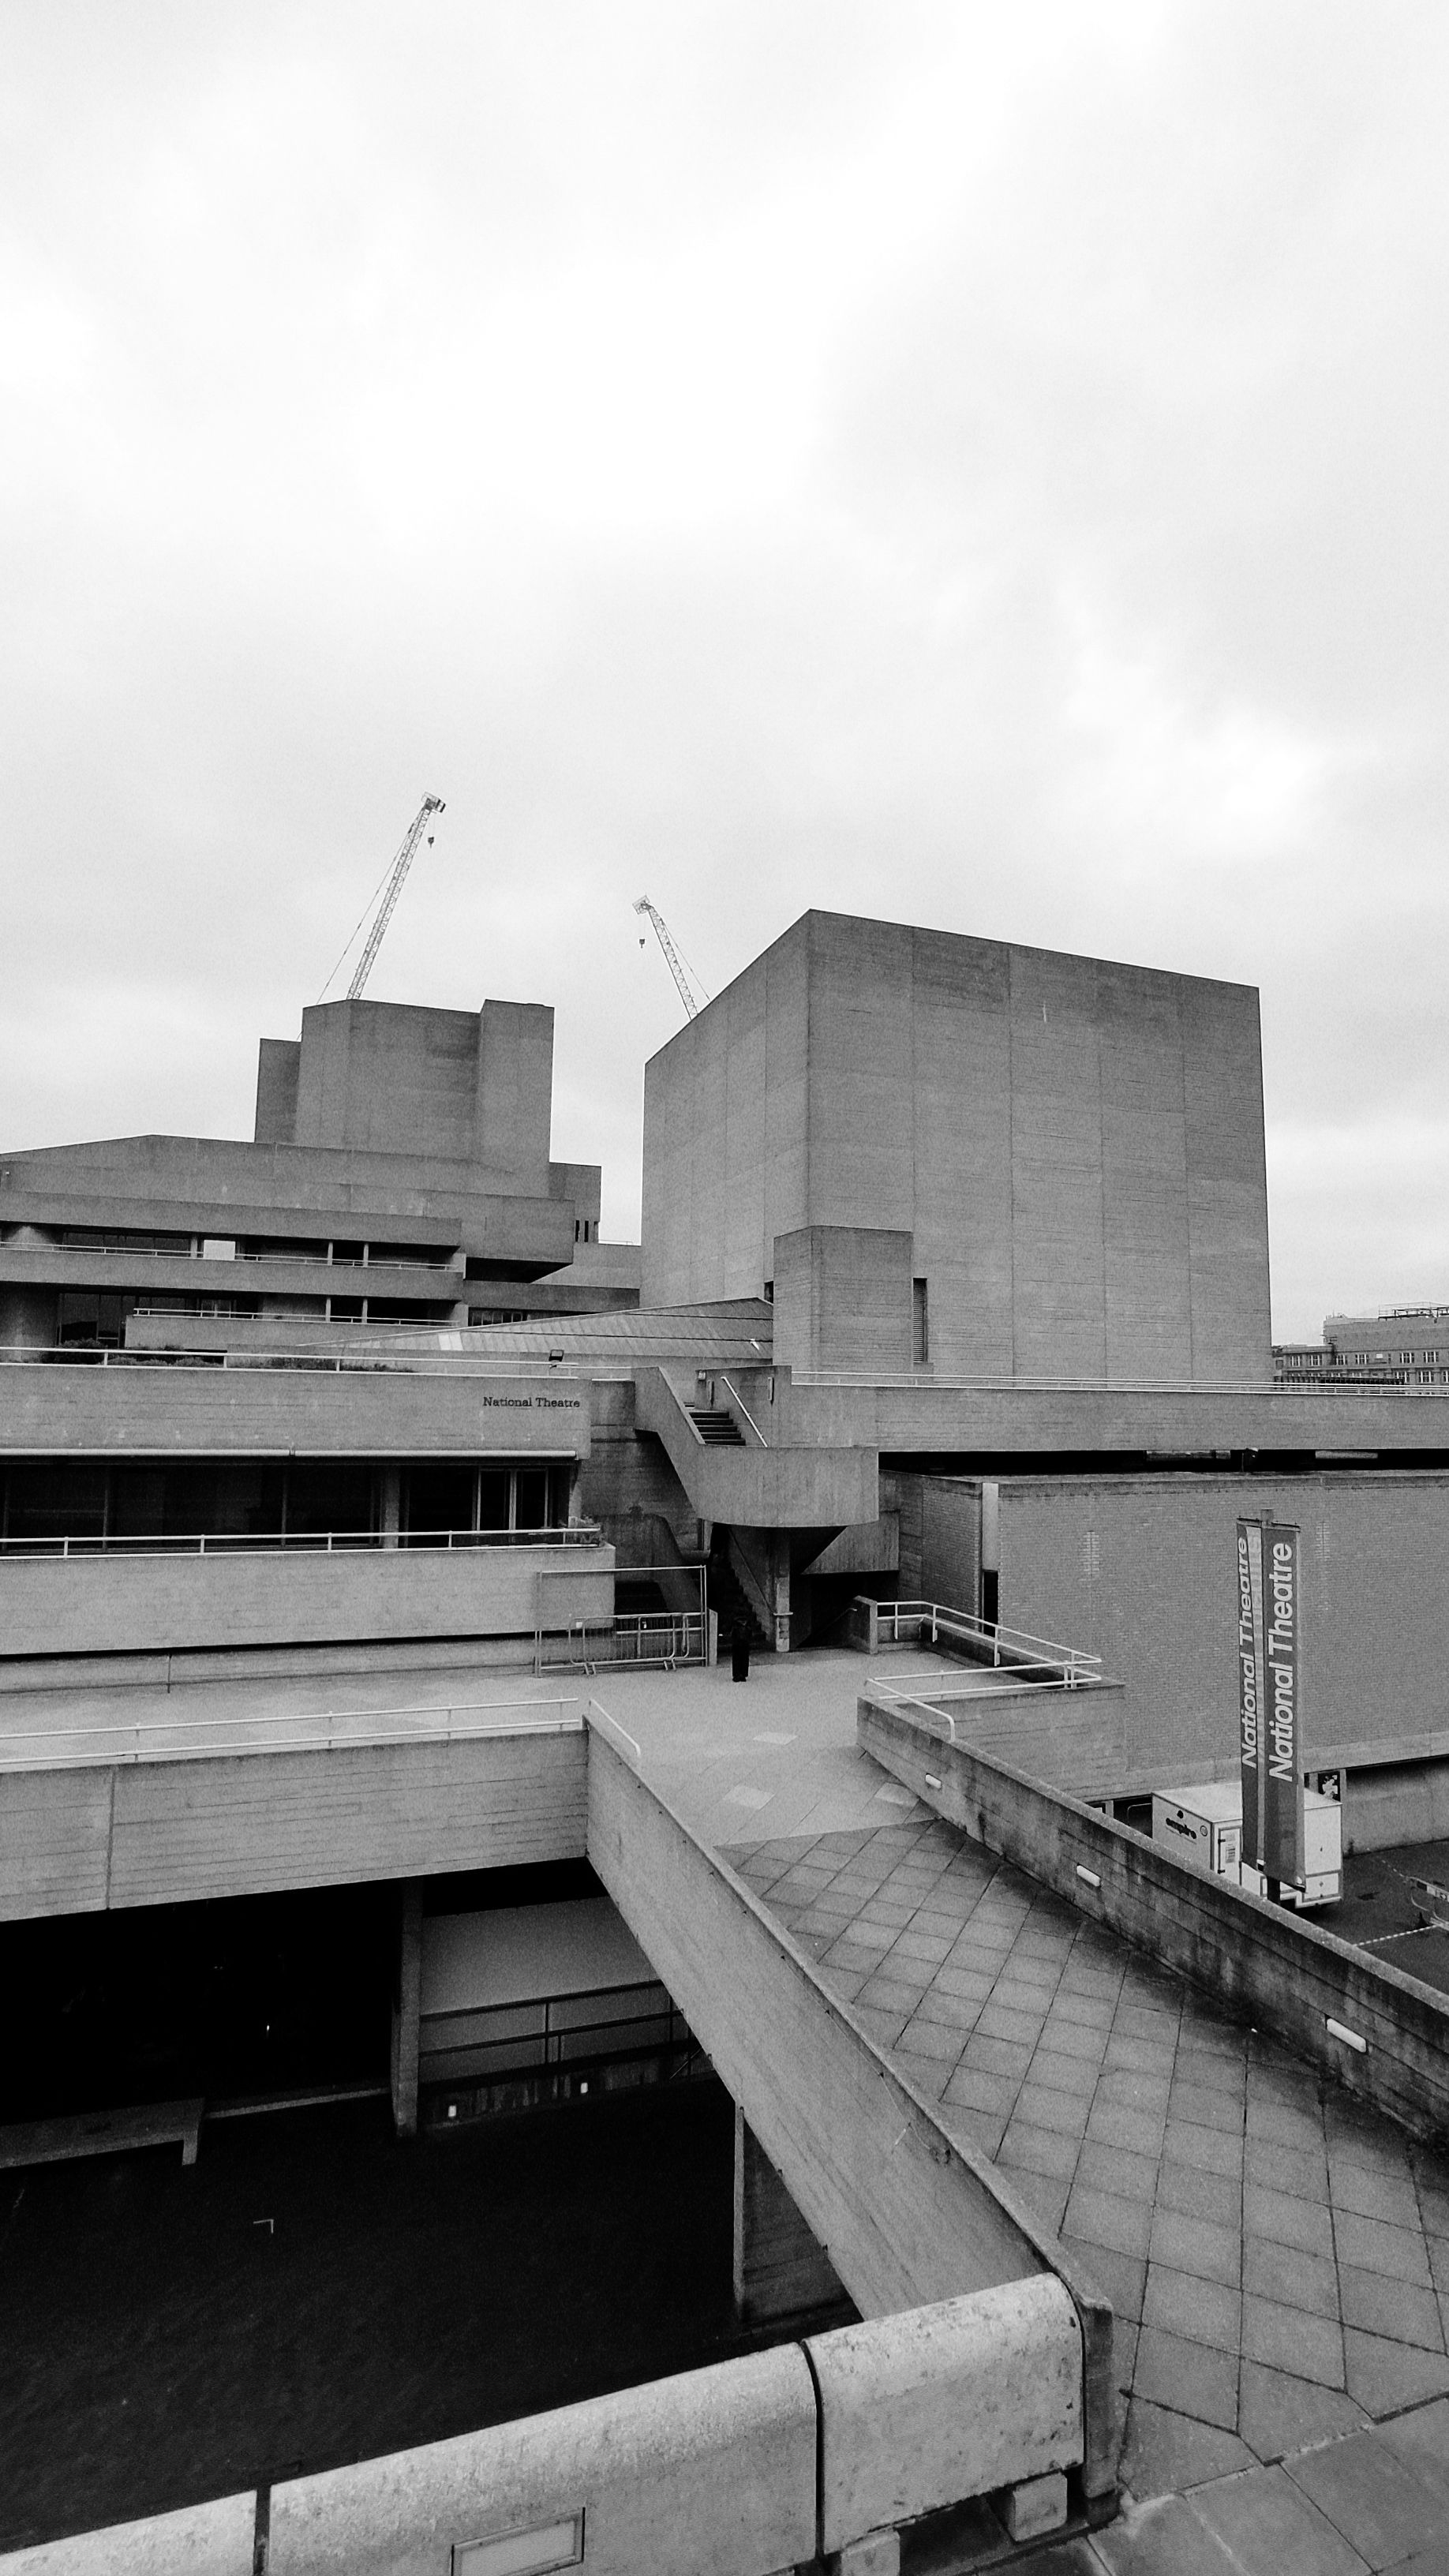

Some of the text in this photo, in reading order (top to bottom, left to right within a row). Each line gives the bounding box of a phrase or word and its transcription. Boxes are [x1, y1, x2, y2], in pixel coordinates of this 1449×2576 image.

[483, 1396, 580, 1408] National Theatre
[1238, 1537, 1257, 1769] National Theatre
[1268, 1542, 1294, 1782] National Theatre
